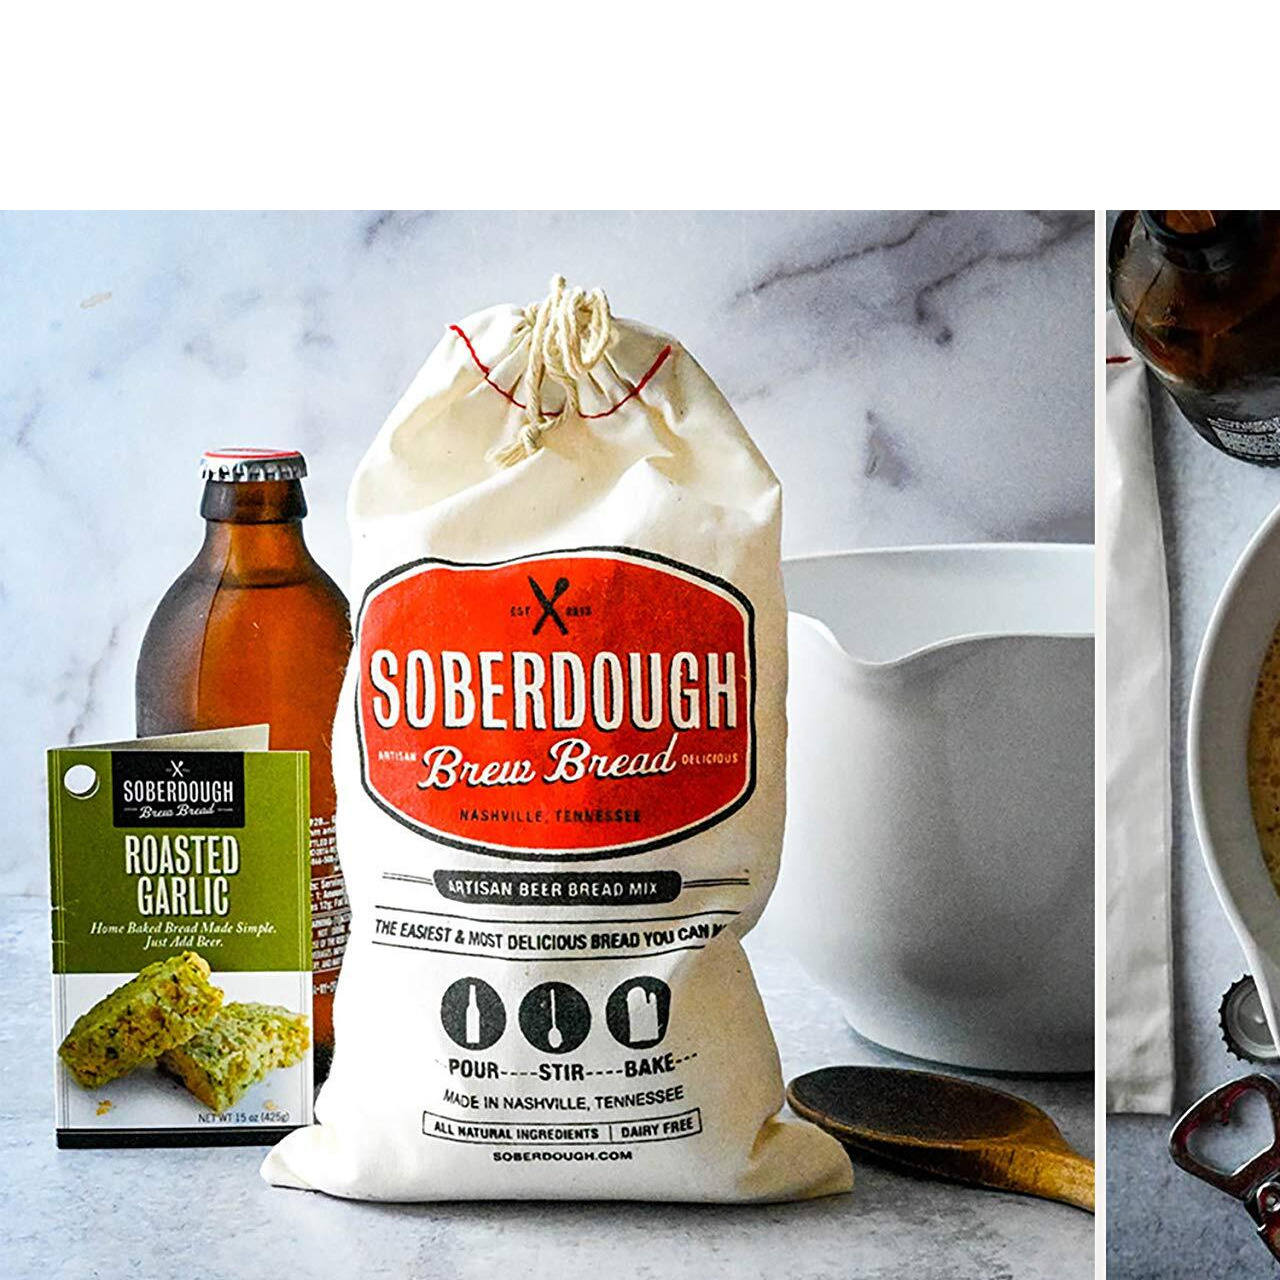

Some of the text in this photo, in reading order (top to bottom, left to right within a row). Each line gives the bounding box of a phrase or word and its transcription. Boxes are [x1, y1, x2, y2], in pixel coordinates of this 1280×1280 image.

[369, 648, 739, 732] SOBERDOUGH
[417, 745, 538, 791] Brew
[542, 731, 680, 783] Bread
[681, 752, 739, 766] DELICIOUS
[122, 779, 234, 803] SOBERDOUGH
[139, 801, 216, 820] Brew Bread
[556, 808, 642, 823] TENNESSEE
[124, 833, 241, 876] ROASTED
[137, 875, 231, 917] GARLIC
[448, 879, 659, 898] ARTISAN BEER BREAD MIX
[90, 921, 278, 938] Home Baked Bread Made Simple.
[375, 918, 398, 937] THE
[400, 921, 453, 944] EASIEST
[454, 928, 466, 946] &
[468, 929, 504, 949] MOST
[507, 933, 588, 951] DELICIOUS
[590, 931, 641, 949] BREAD
[642, 928, 676, 947] YOU
[677, 922, 710, 941] CAN
[143, 934, 224, 951] Just Add Beer.
[448, 1051, 676, 1082] POUR STIR BAKE
[442, 1084, 685, 1112] MADE IN NASHVILLE, TENNESSEE
[197, 1110, 290, 1124] NET WT 15 oz (425g)
[434, 1116, 695, 1141] ALL NATURAL INGREDIENTS DAIRY FREE
[492, 1150, 634, 1163] SOBERDOUGH.COM
